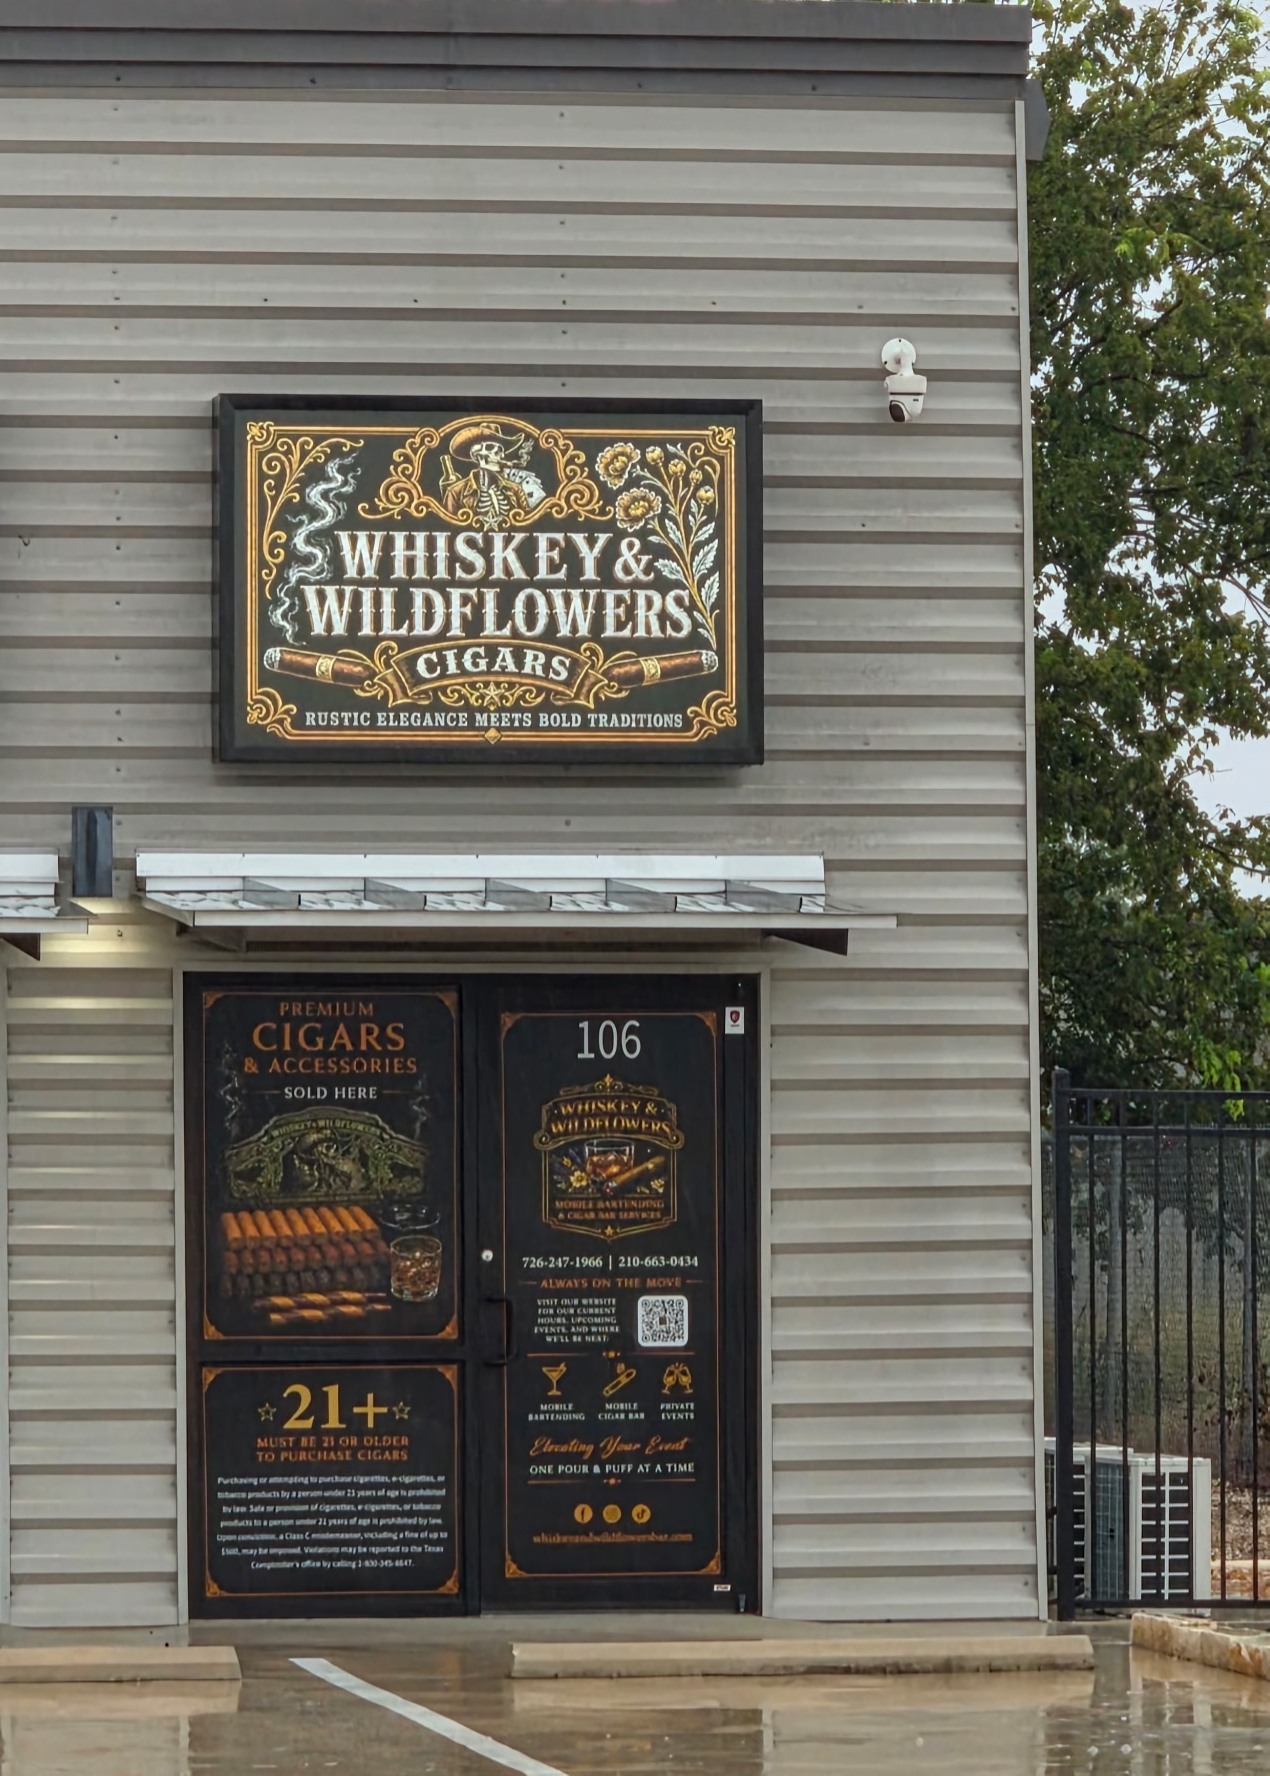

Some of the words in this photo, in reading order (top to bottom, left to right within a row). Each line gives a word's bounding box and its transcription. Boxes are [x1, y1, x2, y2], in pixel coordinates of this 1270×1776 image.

[334, 530, 612, 582] WHISKEY
[613, 536, 655, 583] &
[300, 585, 693, 639] WILDFLOWERS
[415, 647, 571, 682] CIGARS
[305, 712, 371, 727] RUSTIC
[377, 712, 468, 727] ELEGANCE
[475, 712, 531, 727] MEETS
[538, 712, 581, 727] BOLD
[587, 712, 683, 728] TRADITIONS
[279, 1001, 375, 1017] PREMIUM
[252, 1022, 406, 1053] CIGARS
[577, 1020, 641, 1059] 106
[244, 1058, 259, 1074] &
[269, 1056, 418, 1074] ACCESSORIES
[284, 1087, 328, 1100] SOLD
[334, 1086, 378, 1099] HERE
[559, 1098, 641, 1115] WHISKEY
[645, 1101, 658, 1115] &
[550, 1116, 672, 1135] WILDFLOWERS
[555, 1200, 594, 1209] MOBILE
[597, 1199, 665, 1209] BARTENDING
[522, 1256, 603, 1268] 726-247-1966
[618, 1255, 699, 1268] 210-663-0434
[540, 1278, 588, 1289] ALWAYS
[592, 1278, 611, 1288] ON
[616, 1277, 641, 1288] THE
[646, 1276, 682, 1288] MOVE
[537, 1298, 558, 1306] VISIT
[560, 1298, 579, 1306] OUR
[538, 1307, 554, 1315] FOR
[556, 1307, 575, 1315] OUR
[577, 1307, 617, 1315] CURRENT
[571, 1316, 617, 1324] UPCOMING
[591, 1325, 620, 1333] WHERE
[282, 1383, 389, 1429] 21+
[540, 1403, 574, 1411] MOBILE
[604, 1402, 638, 1410] MOBILE
[660, 1402, 695, 1410] PRIVATE
[528, 1413, 586, 1421] BARTENDING
[598, 1412, 626, 1420] CIGAR
[628, 1412, 645, 1420] BAR
[661, 1412, 695, 1420] EVENTS
[256, 1436, 296, 1448] MUST
[300, 1436, 316, 1447] BE
[322, 1436, 335, 1447] 21
[339, 1436, 358, 1447] OR
[363, 1435, 409, 1446] OLDER
[529, 1436, 595, 1460] Elevating
[598, 1435, 641, 1460] Your
[644, 1434, 691, 1455] Event
[256, 1451, 275, 1462] TO
[280, 1450, 352, 1462] PURCHASE
[357, 1449, 409, 1461] CIGARS
[529, 1465, 554, 1474] ONE
[558, 1464, 589, 1474] POUR
[605, 1464, 634, 1474] PUFF
[637, 1463, 652, 1473] AT
[654, 1463, 663, 1473] A
[666, 1462, 695, 1473] TIME
[281, 1490, 290, 1499] by
